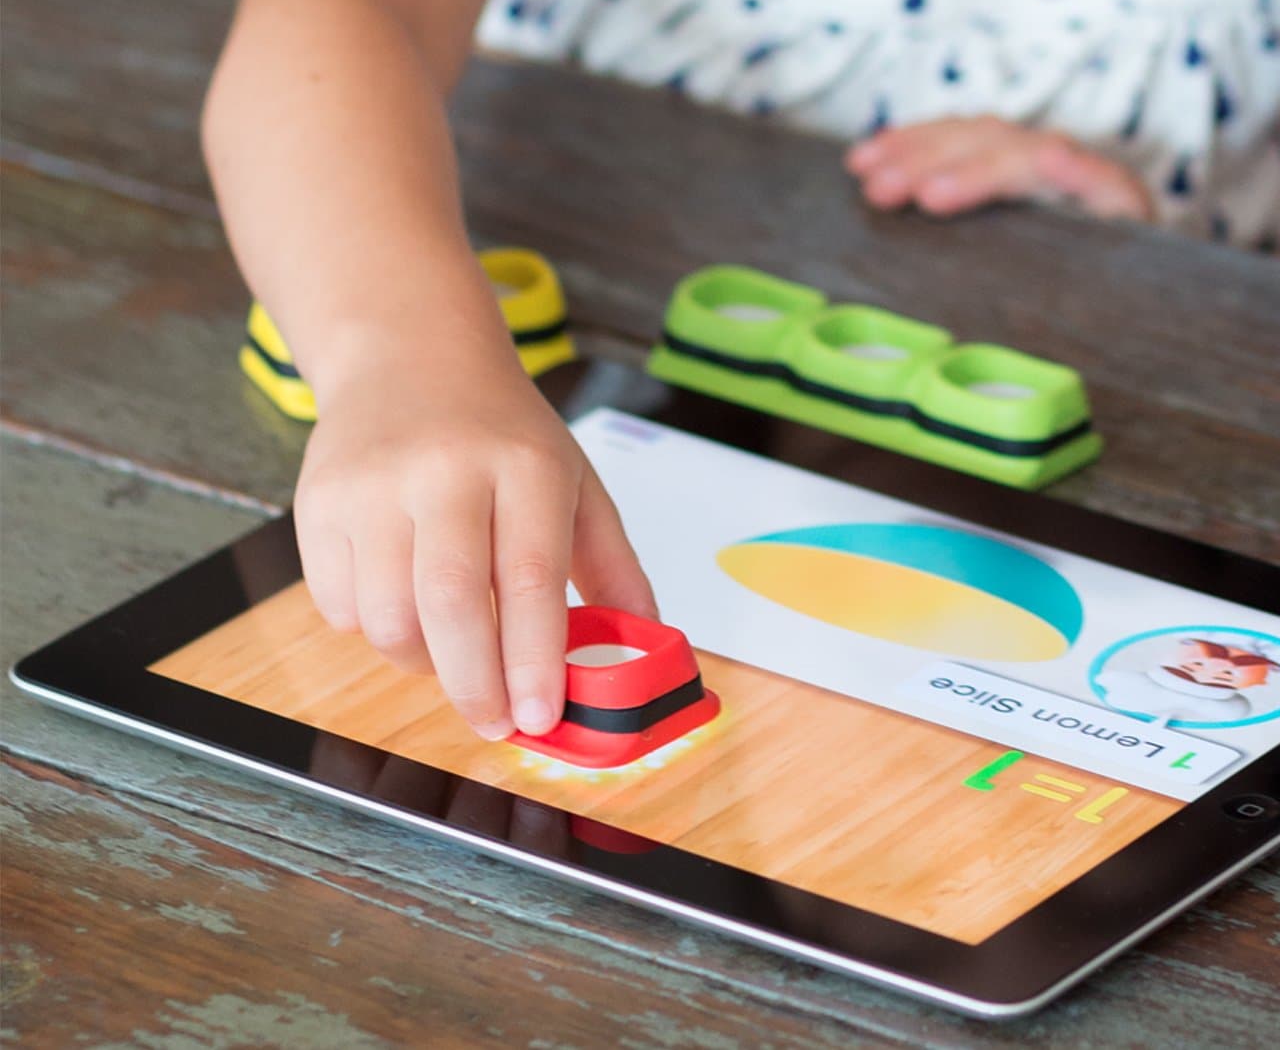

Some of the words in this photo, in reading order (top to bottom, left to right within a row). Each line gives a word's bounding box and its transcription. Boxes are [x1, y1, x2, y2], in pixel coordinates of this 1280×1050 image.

[930, 677, 1022, 714] Slice
[1032, 708, 1166, 758] Lemon
[1170, 752, 1197, 769] 1
